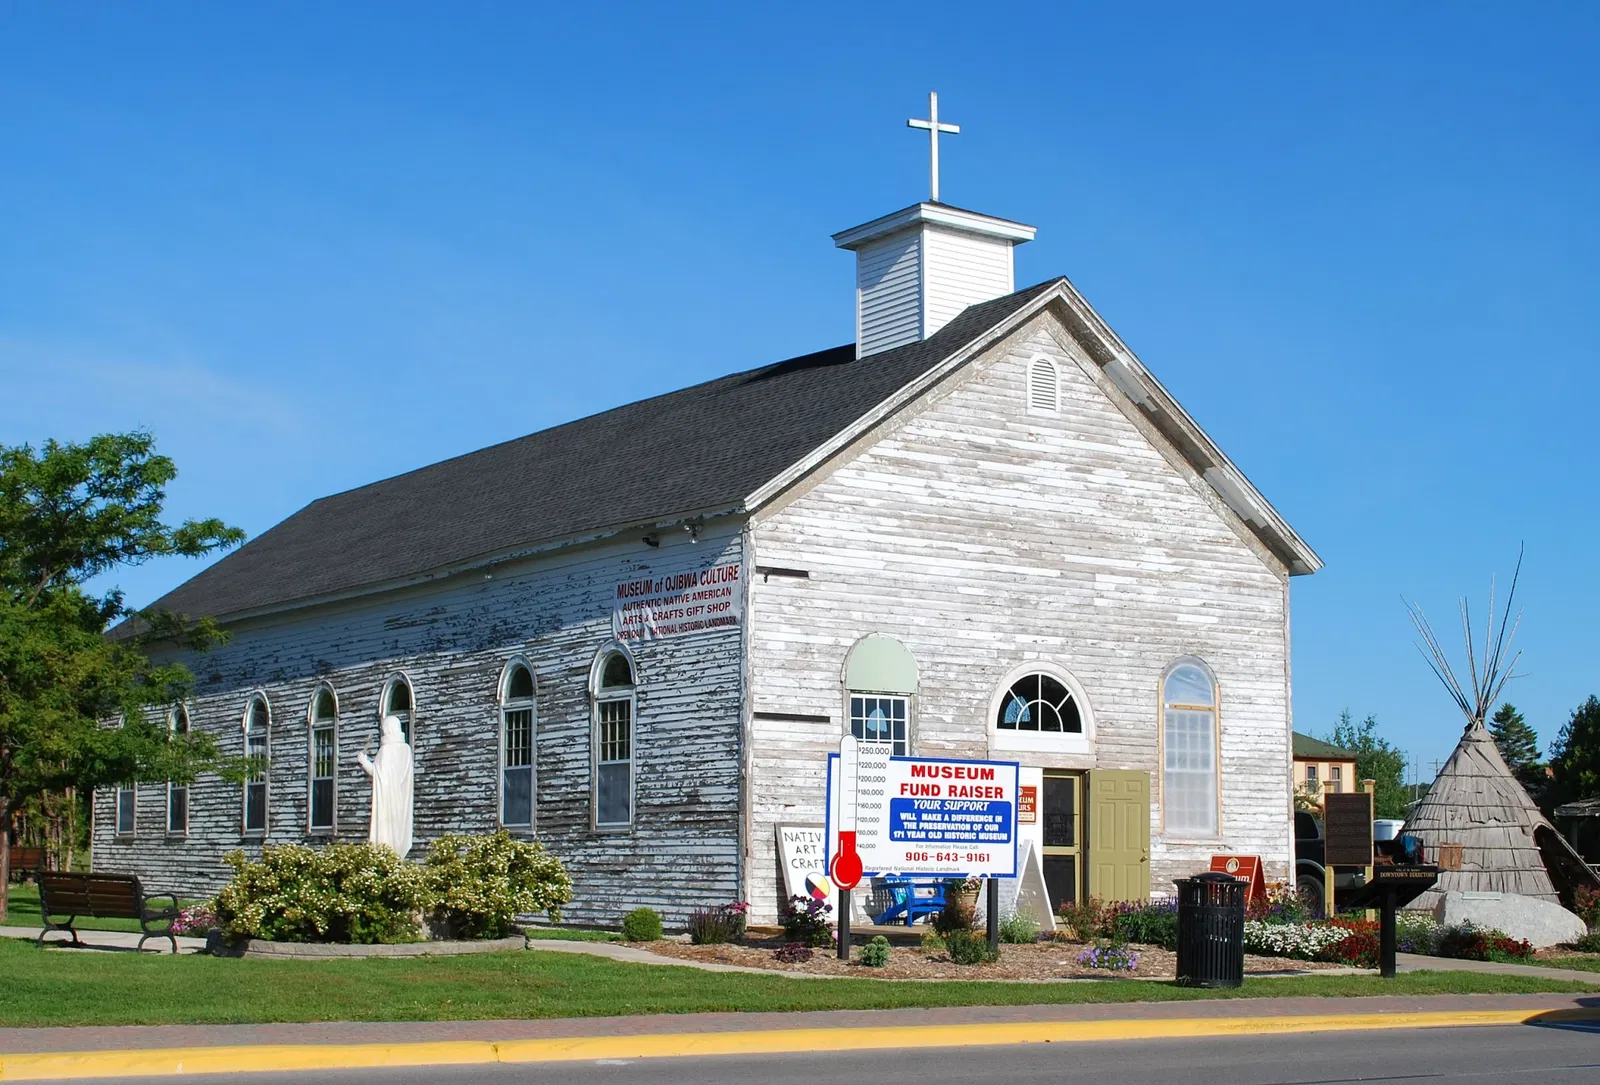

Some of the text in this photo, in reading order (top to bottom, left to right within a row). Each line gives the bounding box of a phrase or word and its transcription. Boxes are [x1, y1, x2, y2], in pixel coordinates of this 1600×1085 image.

[616, 565, 739, 599] MUSEUM of OJIBWA CULTURE
[623, 586, 732, 612] AUTHENTIC NATIVE AMERICAN
[623, 614, 642, 626] ARTS
[652, 608, 684, 621] CRAFTS
[686, 606, 704, 616] GIFT
[706, 602, 730, 614] SHOP
[679, 620, 704, 632] HISTORIC
[704, 616, 737, 628] LANDMARK
[911, 765, 994, 780] MUSEUM
[900, 783, 1003, 798] FUND RAISER
[914, 800, 990, 811] YOUR SUPPORT
[952, 814, 993, 822] DIFFERENCE
[920, 822, 970, 831] PRESERVATION
[784, 832, 821, 842] NATIV
[944, 832, 976, 840] HISTORIC
[796, 844, 816, 854] ART
[906, 852, 990, 862] 906-643-9161
